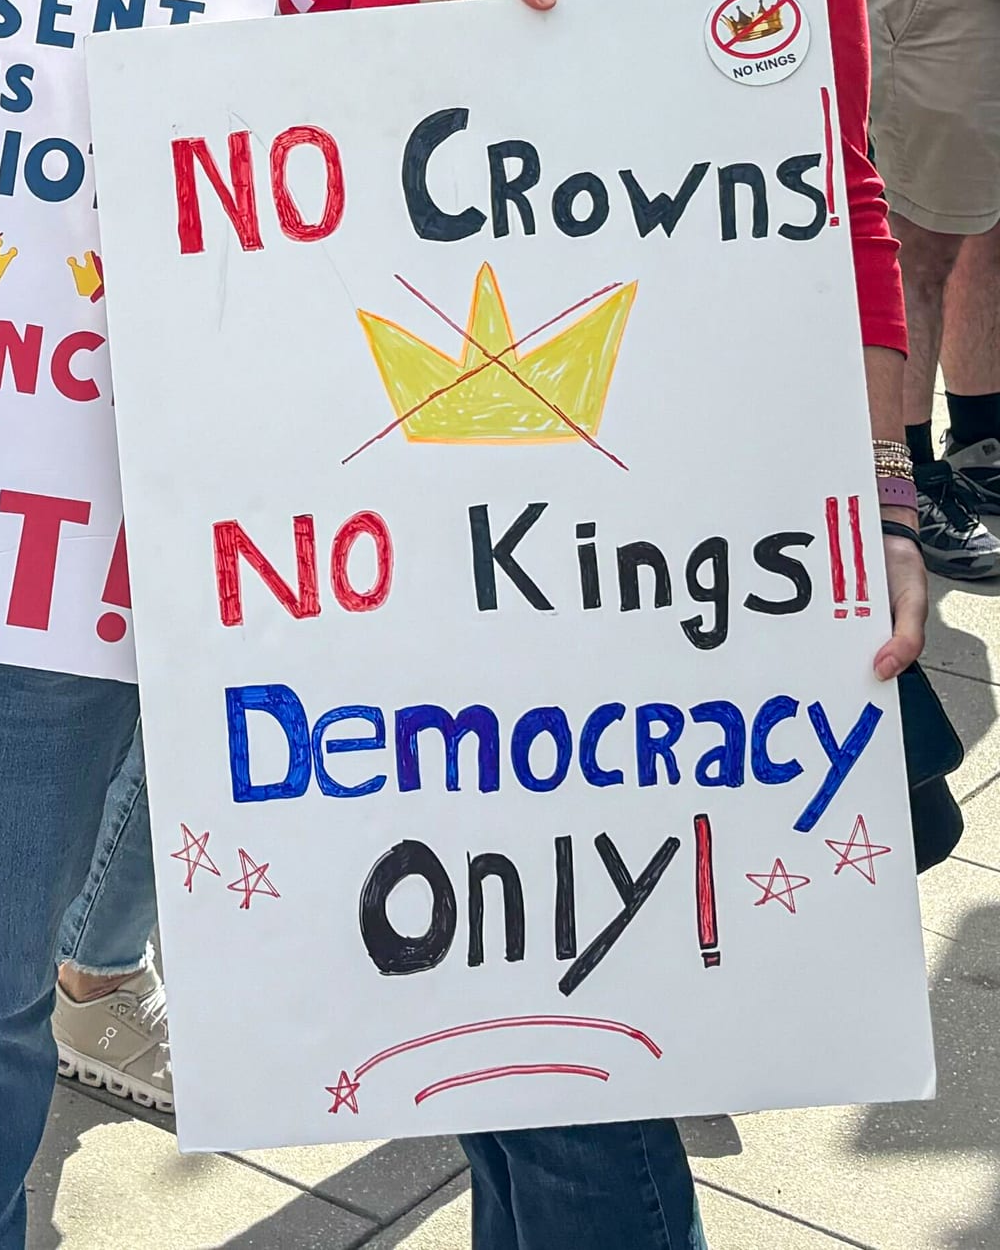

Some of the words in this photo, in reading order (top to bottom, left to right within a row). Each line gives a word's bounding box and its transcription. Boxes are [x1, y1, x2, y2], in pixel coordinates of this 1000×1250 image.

[732, 65, 753, 78] NO
[755, 53, 797, 72] KINGS
[172, 127, 345, 255] NO
[213, 513, 392, 627] NO
[469, 496, 870, 650] Kings!!
